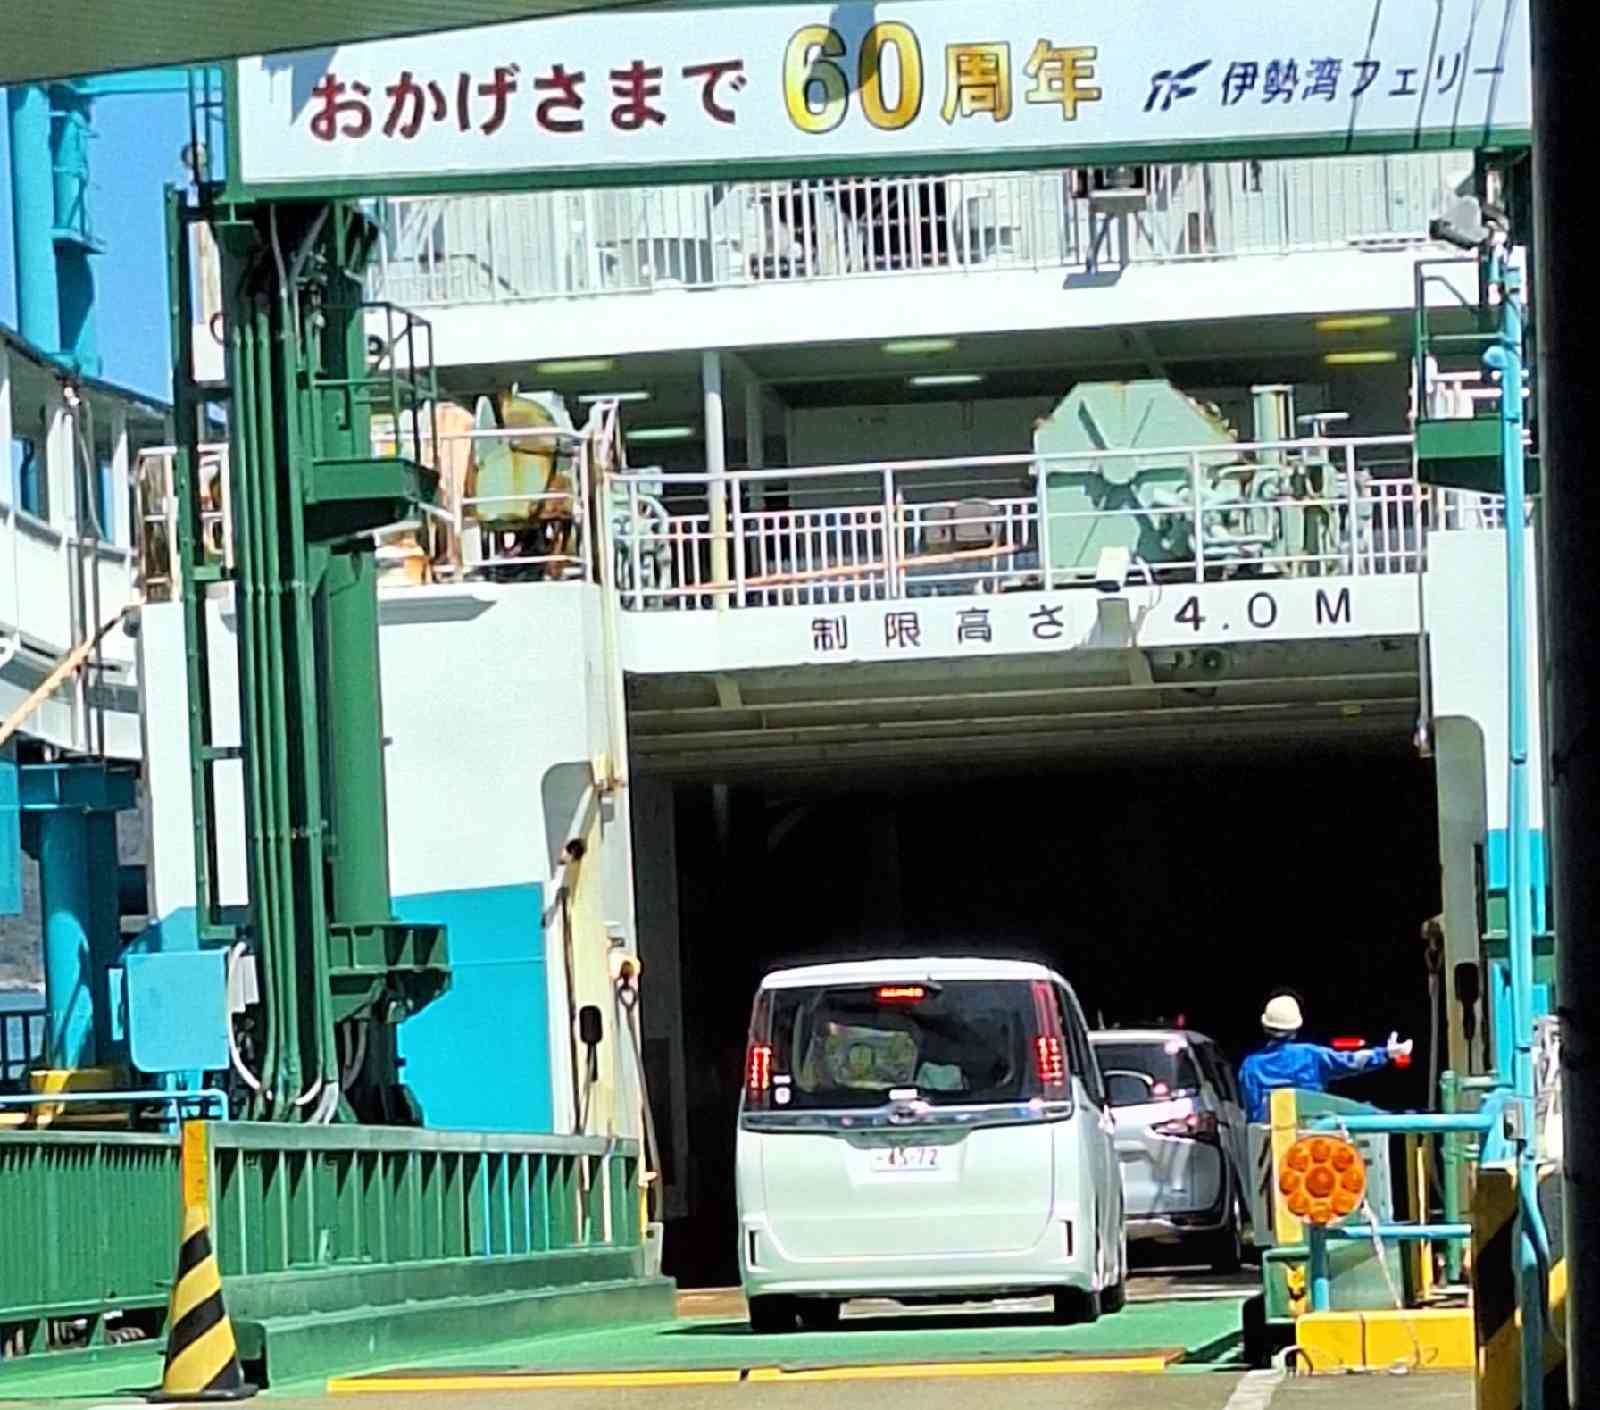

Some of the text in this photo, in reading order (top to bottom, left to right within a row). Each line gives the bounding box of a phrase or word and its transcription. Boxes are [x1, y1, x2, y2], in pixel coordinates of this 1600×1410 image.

[310, 60, 747, 141] おかげさまで
[1221, 52, 1504, 106] 伊勢湾フェリー
[811, 602, 1065, 652] 制限高さ
